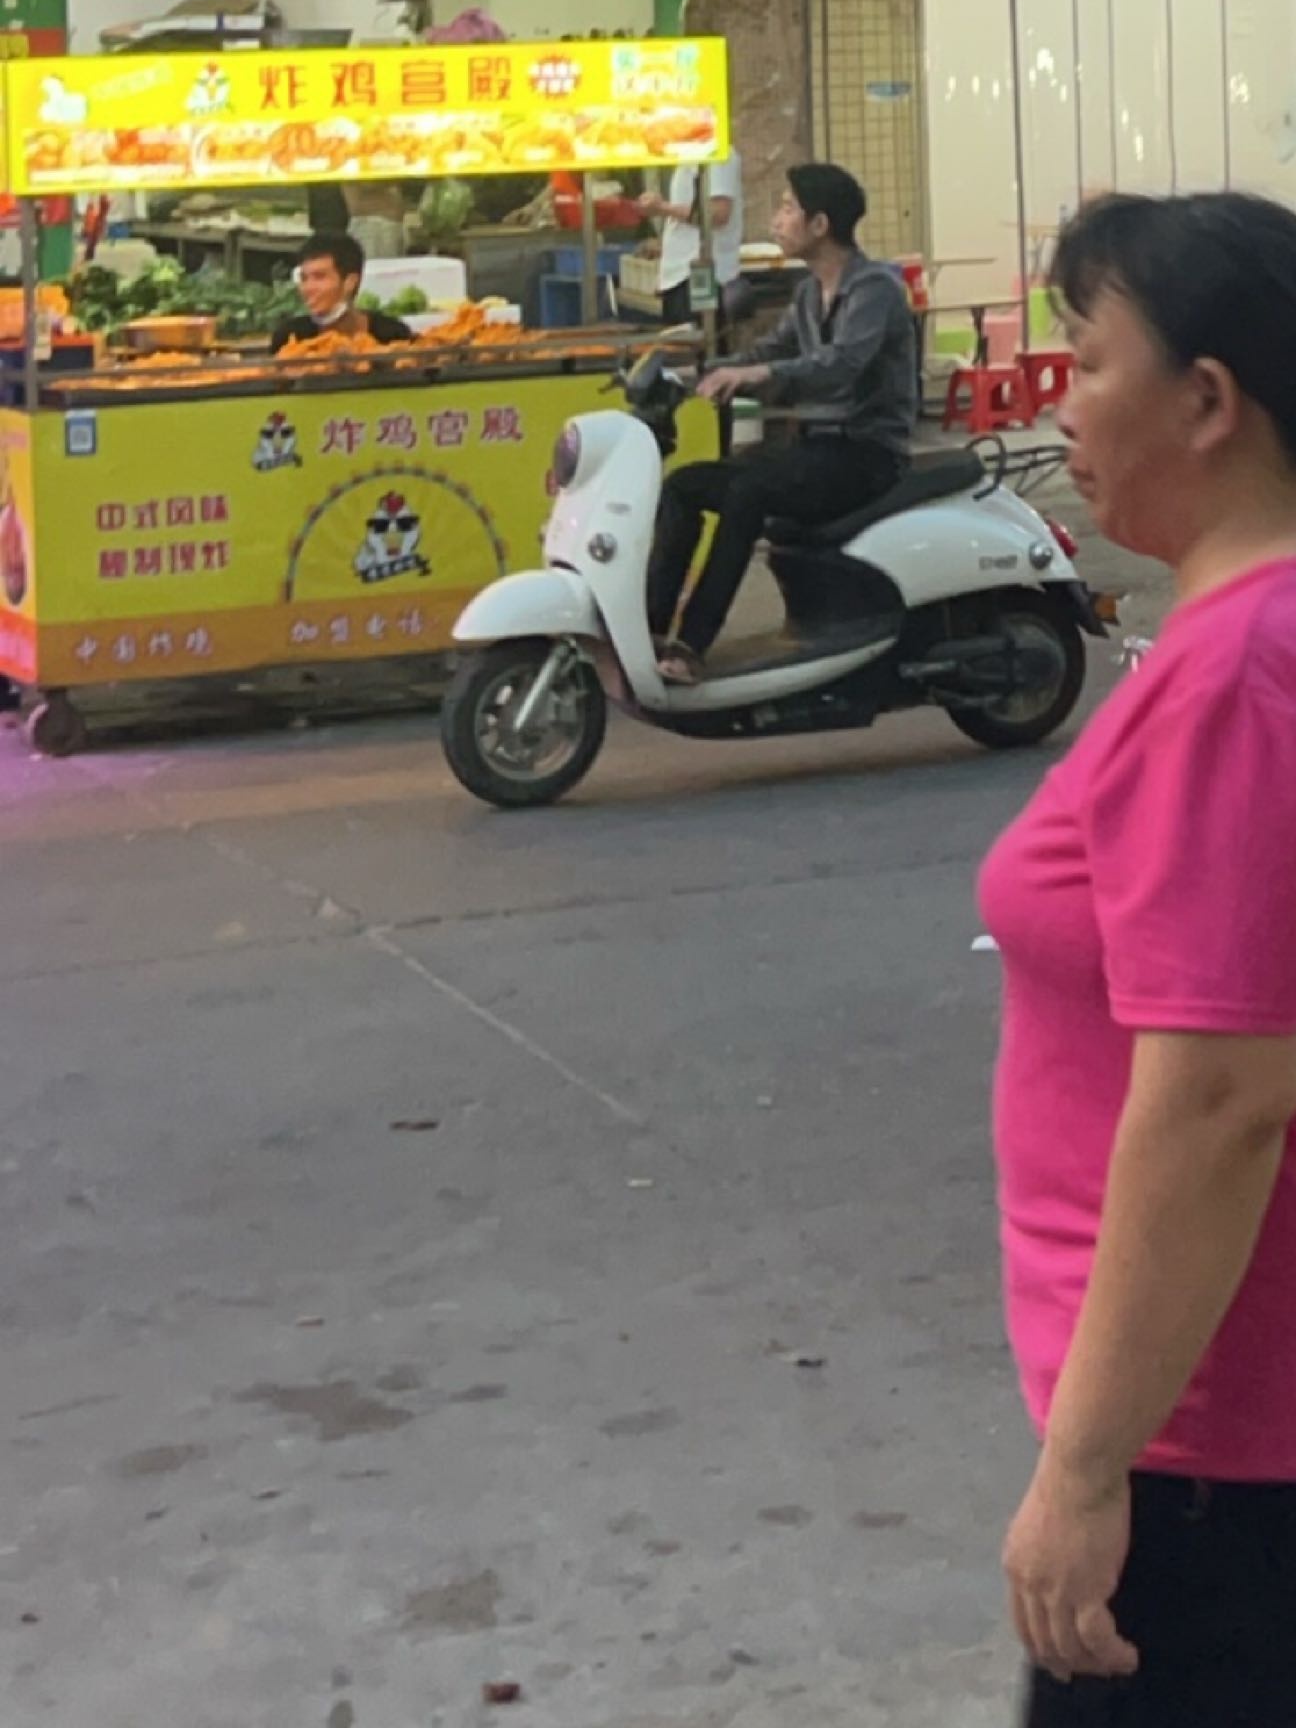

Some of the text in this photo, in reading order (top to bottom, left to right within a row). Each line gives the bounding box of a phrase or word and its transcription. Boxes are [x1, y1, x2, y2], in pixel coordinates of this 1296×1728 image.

[258, 56, 513, 111] 炸鸡宫殿
[321, 405, 524, 456] 炸鸡宫殿
